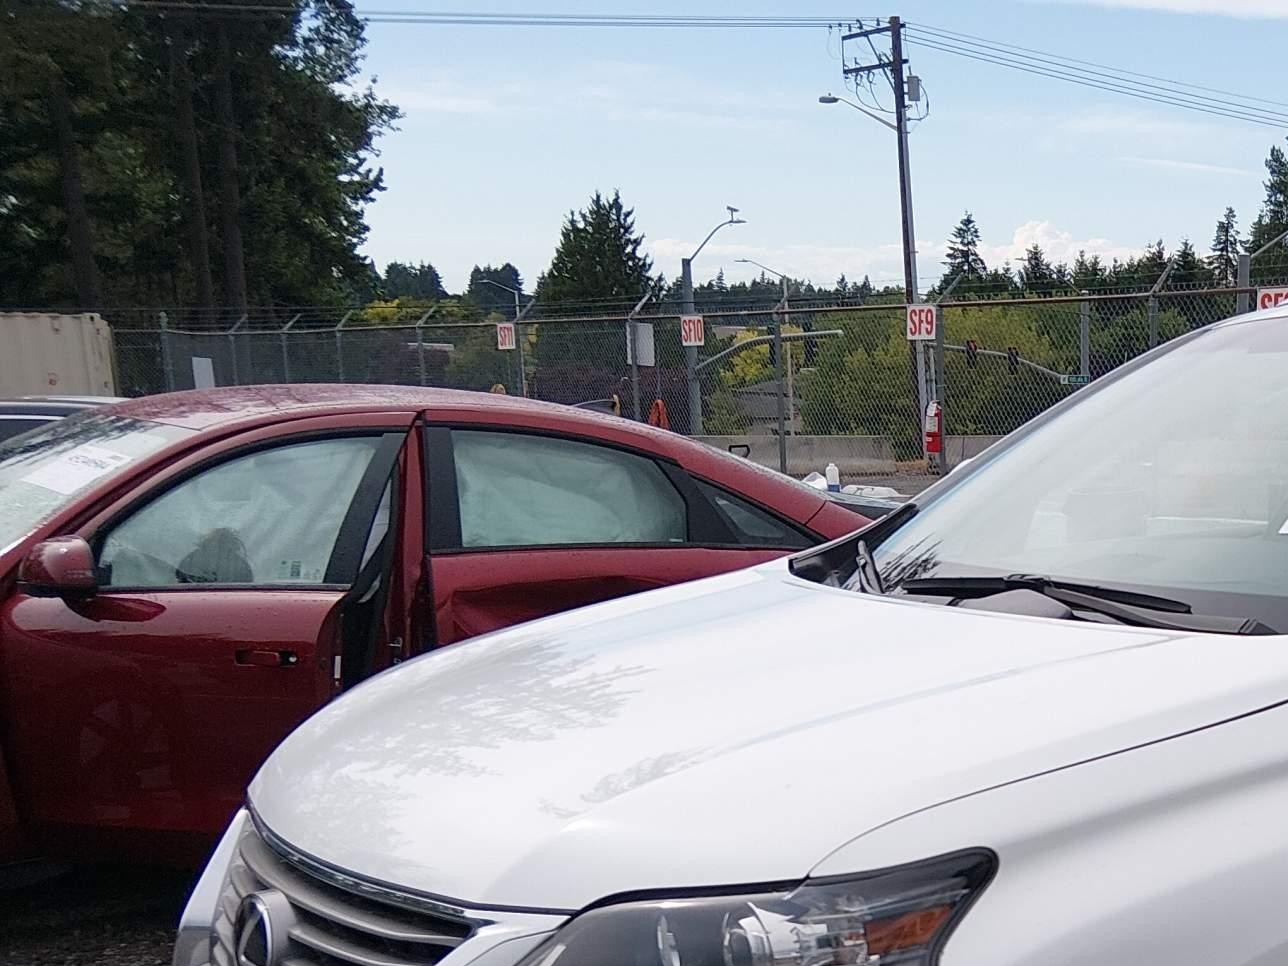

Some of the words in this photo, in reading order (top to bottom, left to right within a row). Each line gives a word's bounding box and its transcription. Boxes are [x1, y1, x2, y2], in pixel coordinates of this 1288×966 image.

[682, 319, 703, 342] SF10
[909, 308, 934, 336] SF9
[499, 326, 513, 347] SF11
